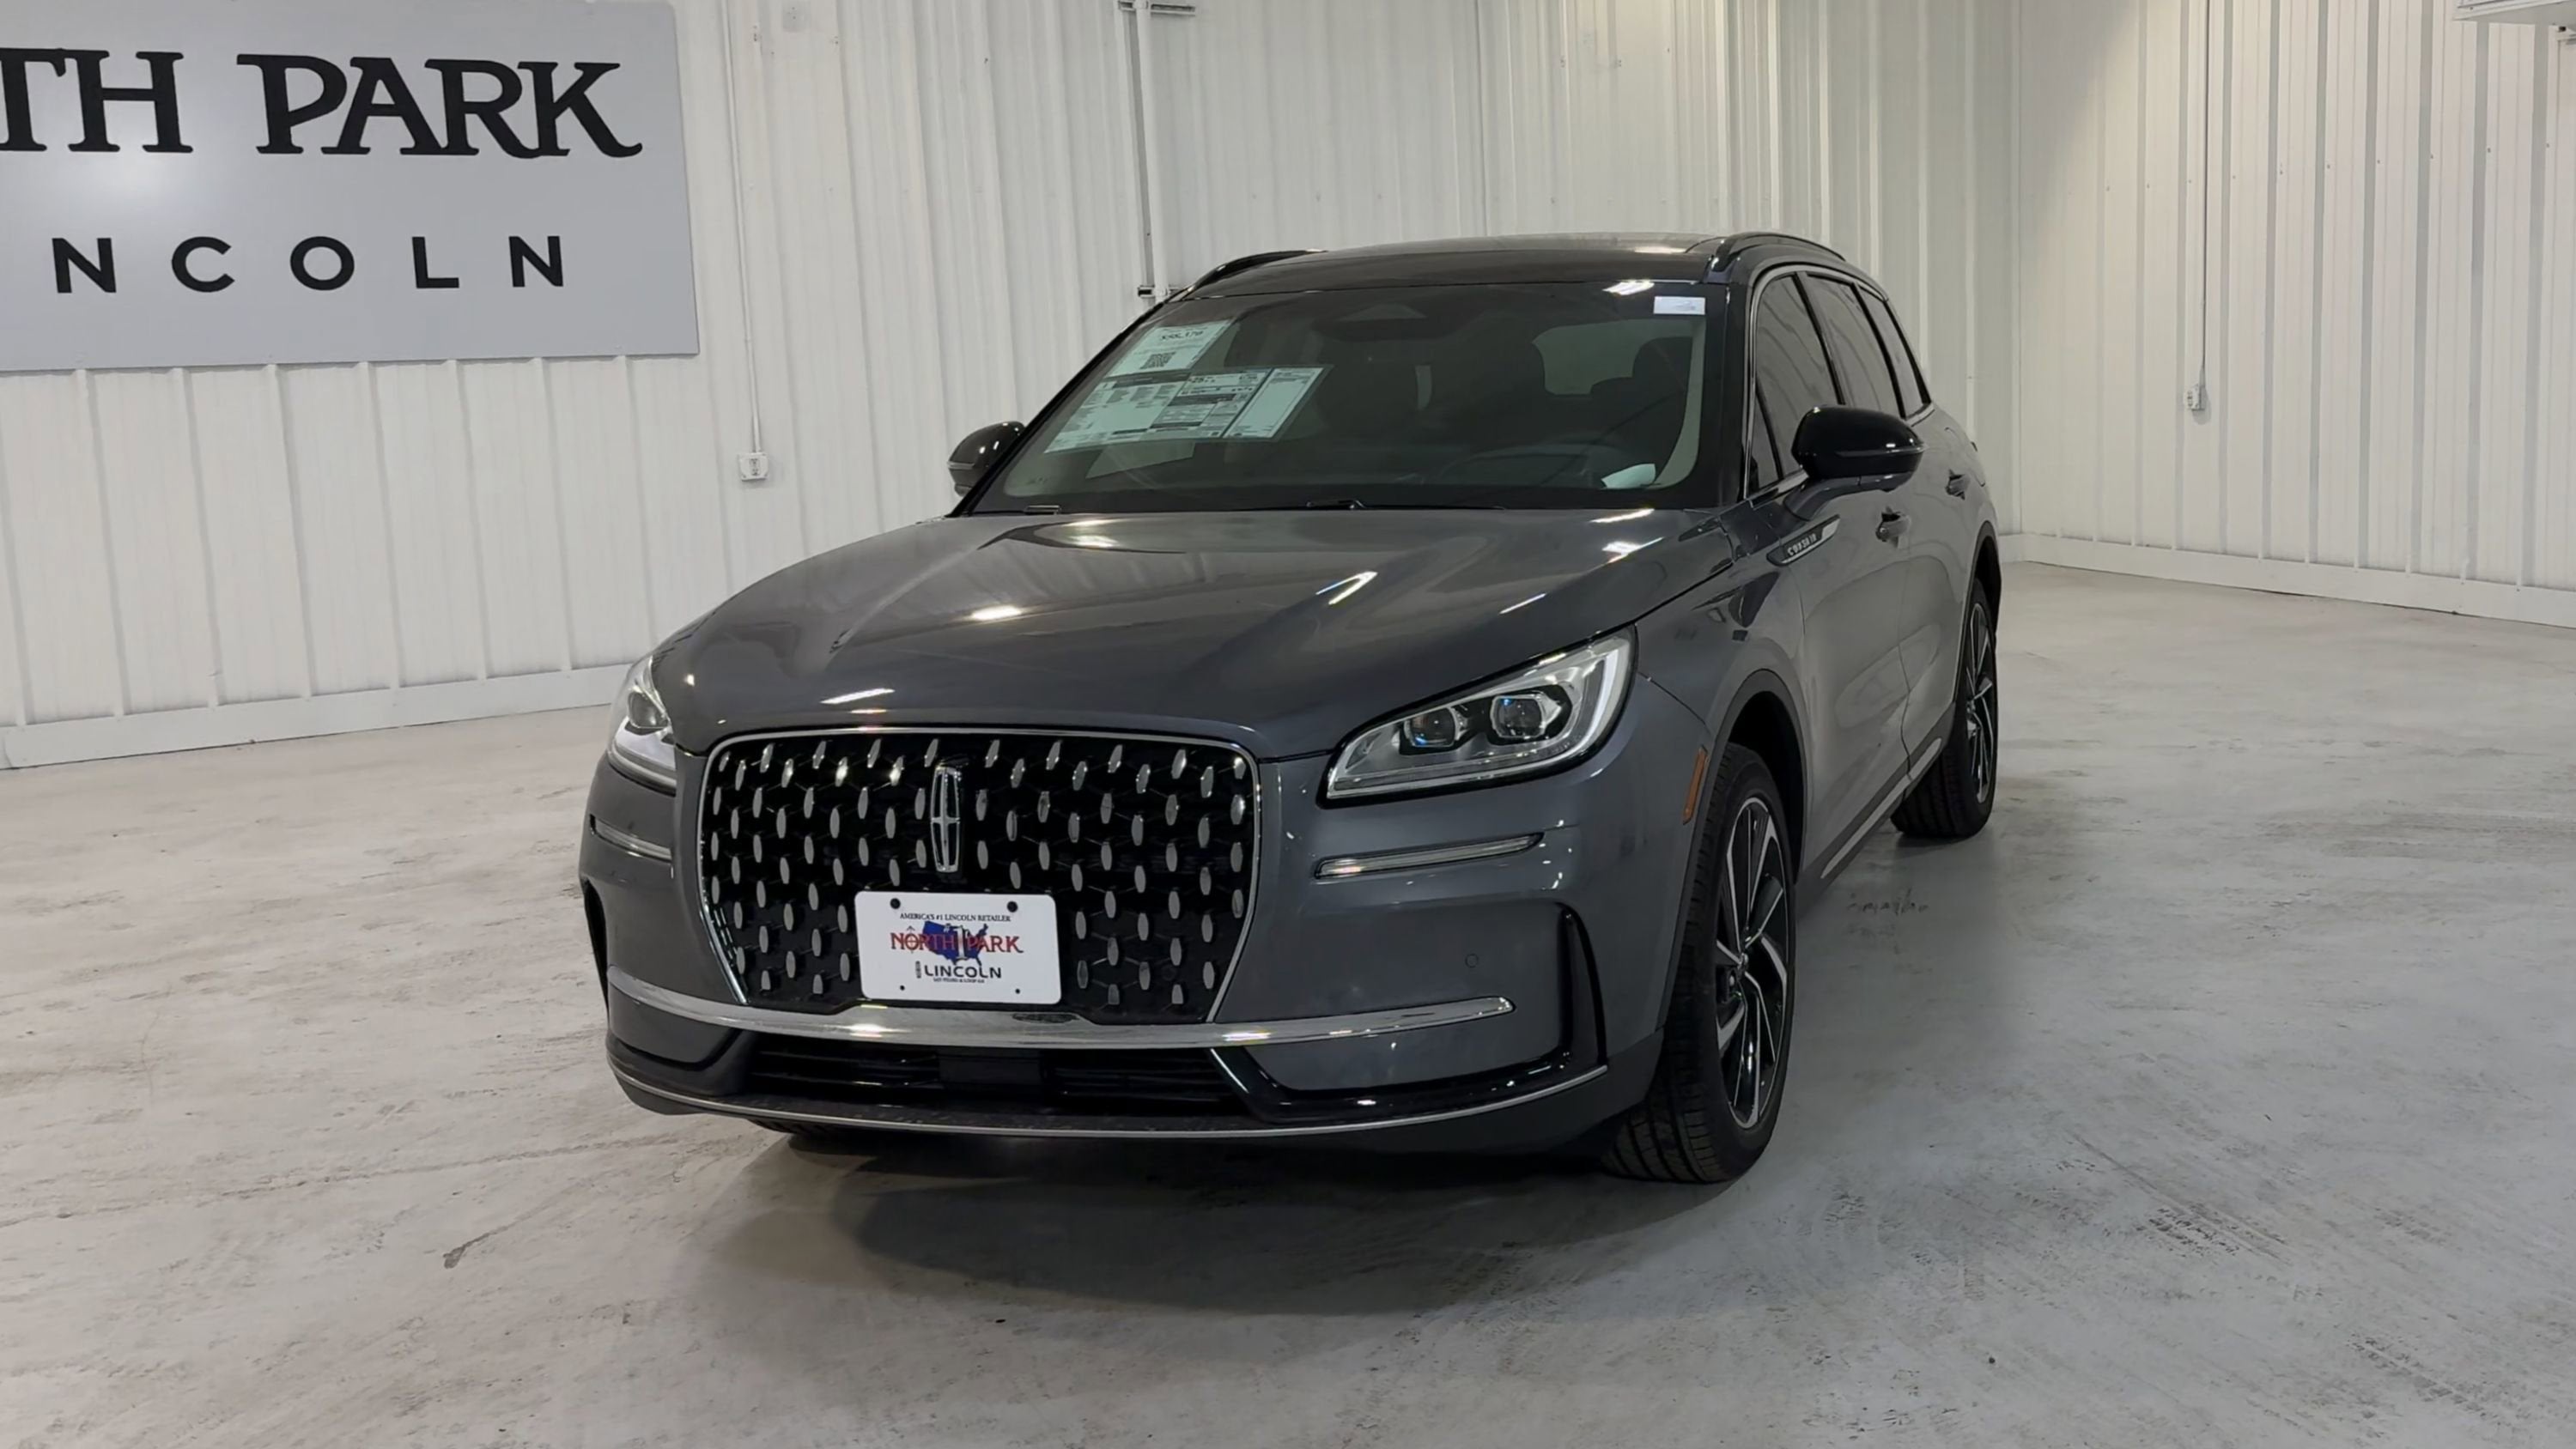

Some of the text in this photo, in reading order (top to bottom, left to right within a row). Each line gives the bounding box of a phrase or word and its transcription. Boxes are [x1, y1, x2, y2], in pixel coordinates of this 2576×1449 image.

[237, 53, 642, 159] PARK
[890, 932, 1024, 953] NORTH PARK
[924, 965, 1001, 979] LINCOLN
